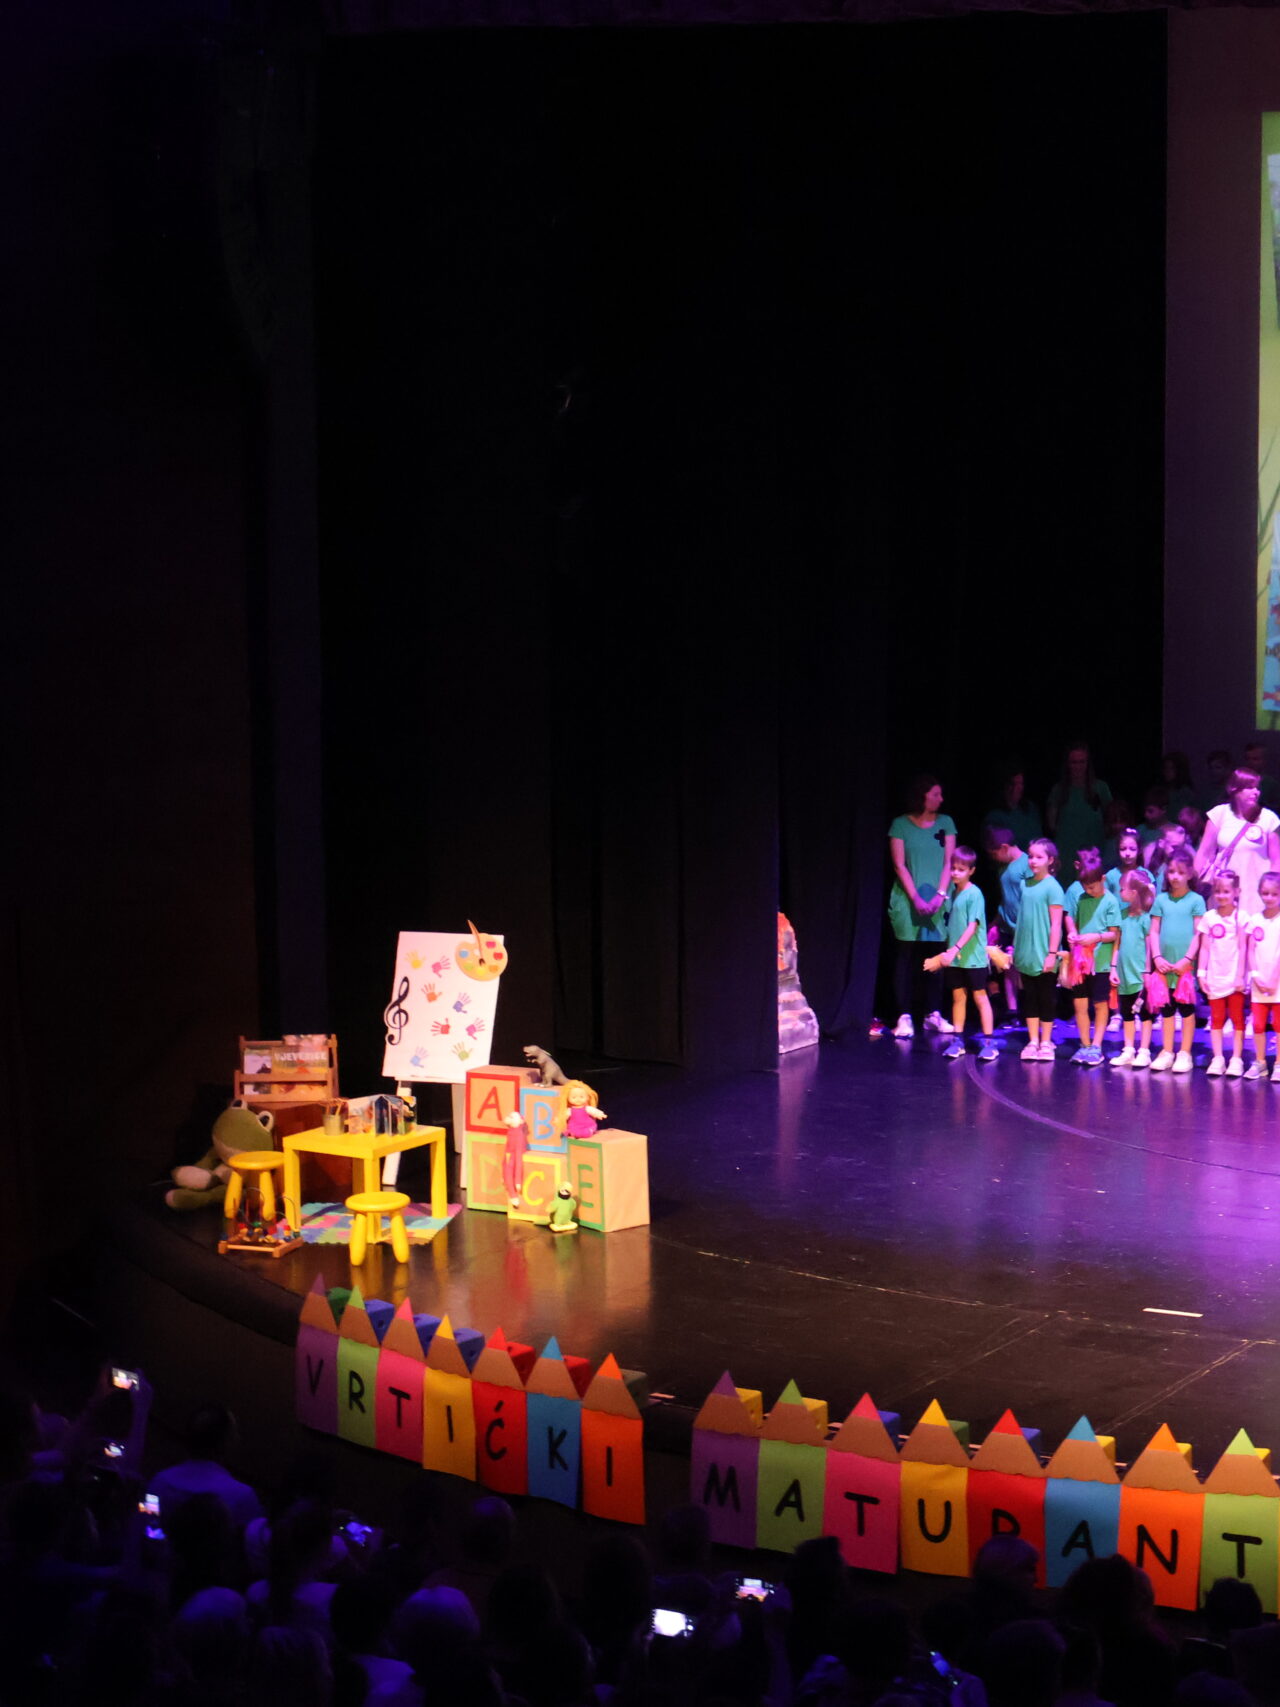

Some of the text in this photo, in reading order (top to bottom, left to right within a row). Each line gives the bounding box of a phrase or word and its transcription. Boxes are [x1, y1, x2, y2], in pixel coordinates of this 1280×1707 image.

[477, 1085, 503, 1122] A
[533, 1101, 555, 1140] B
[523, 1170, 545, 1206] C
[577, 1163, 594, 1208] E
[306, 1353, 614, 1488] VRTIĆKI
